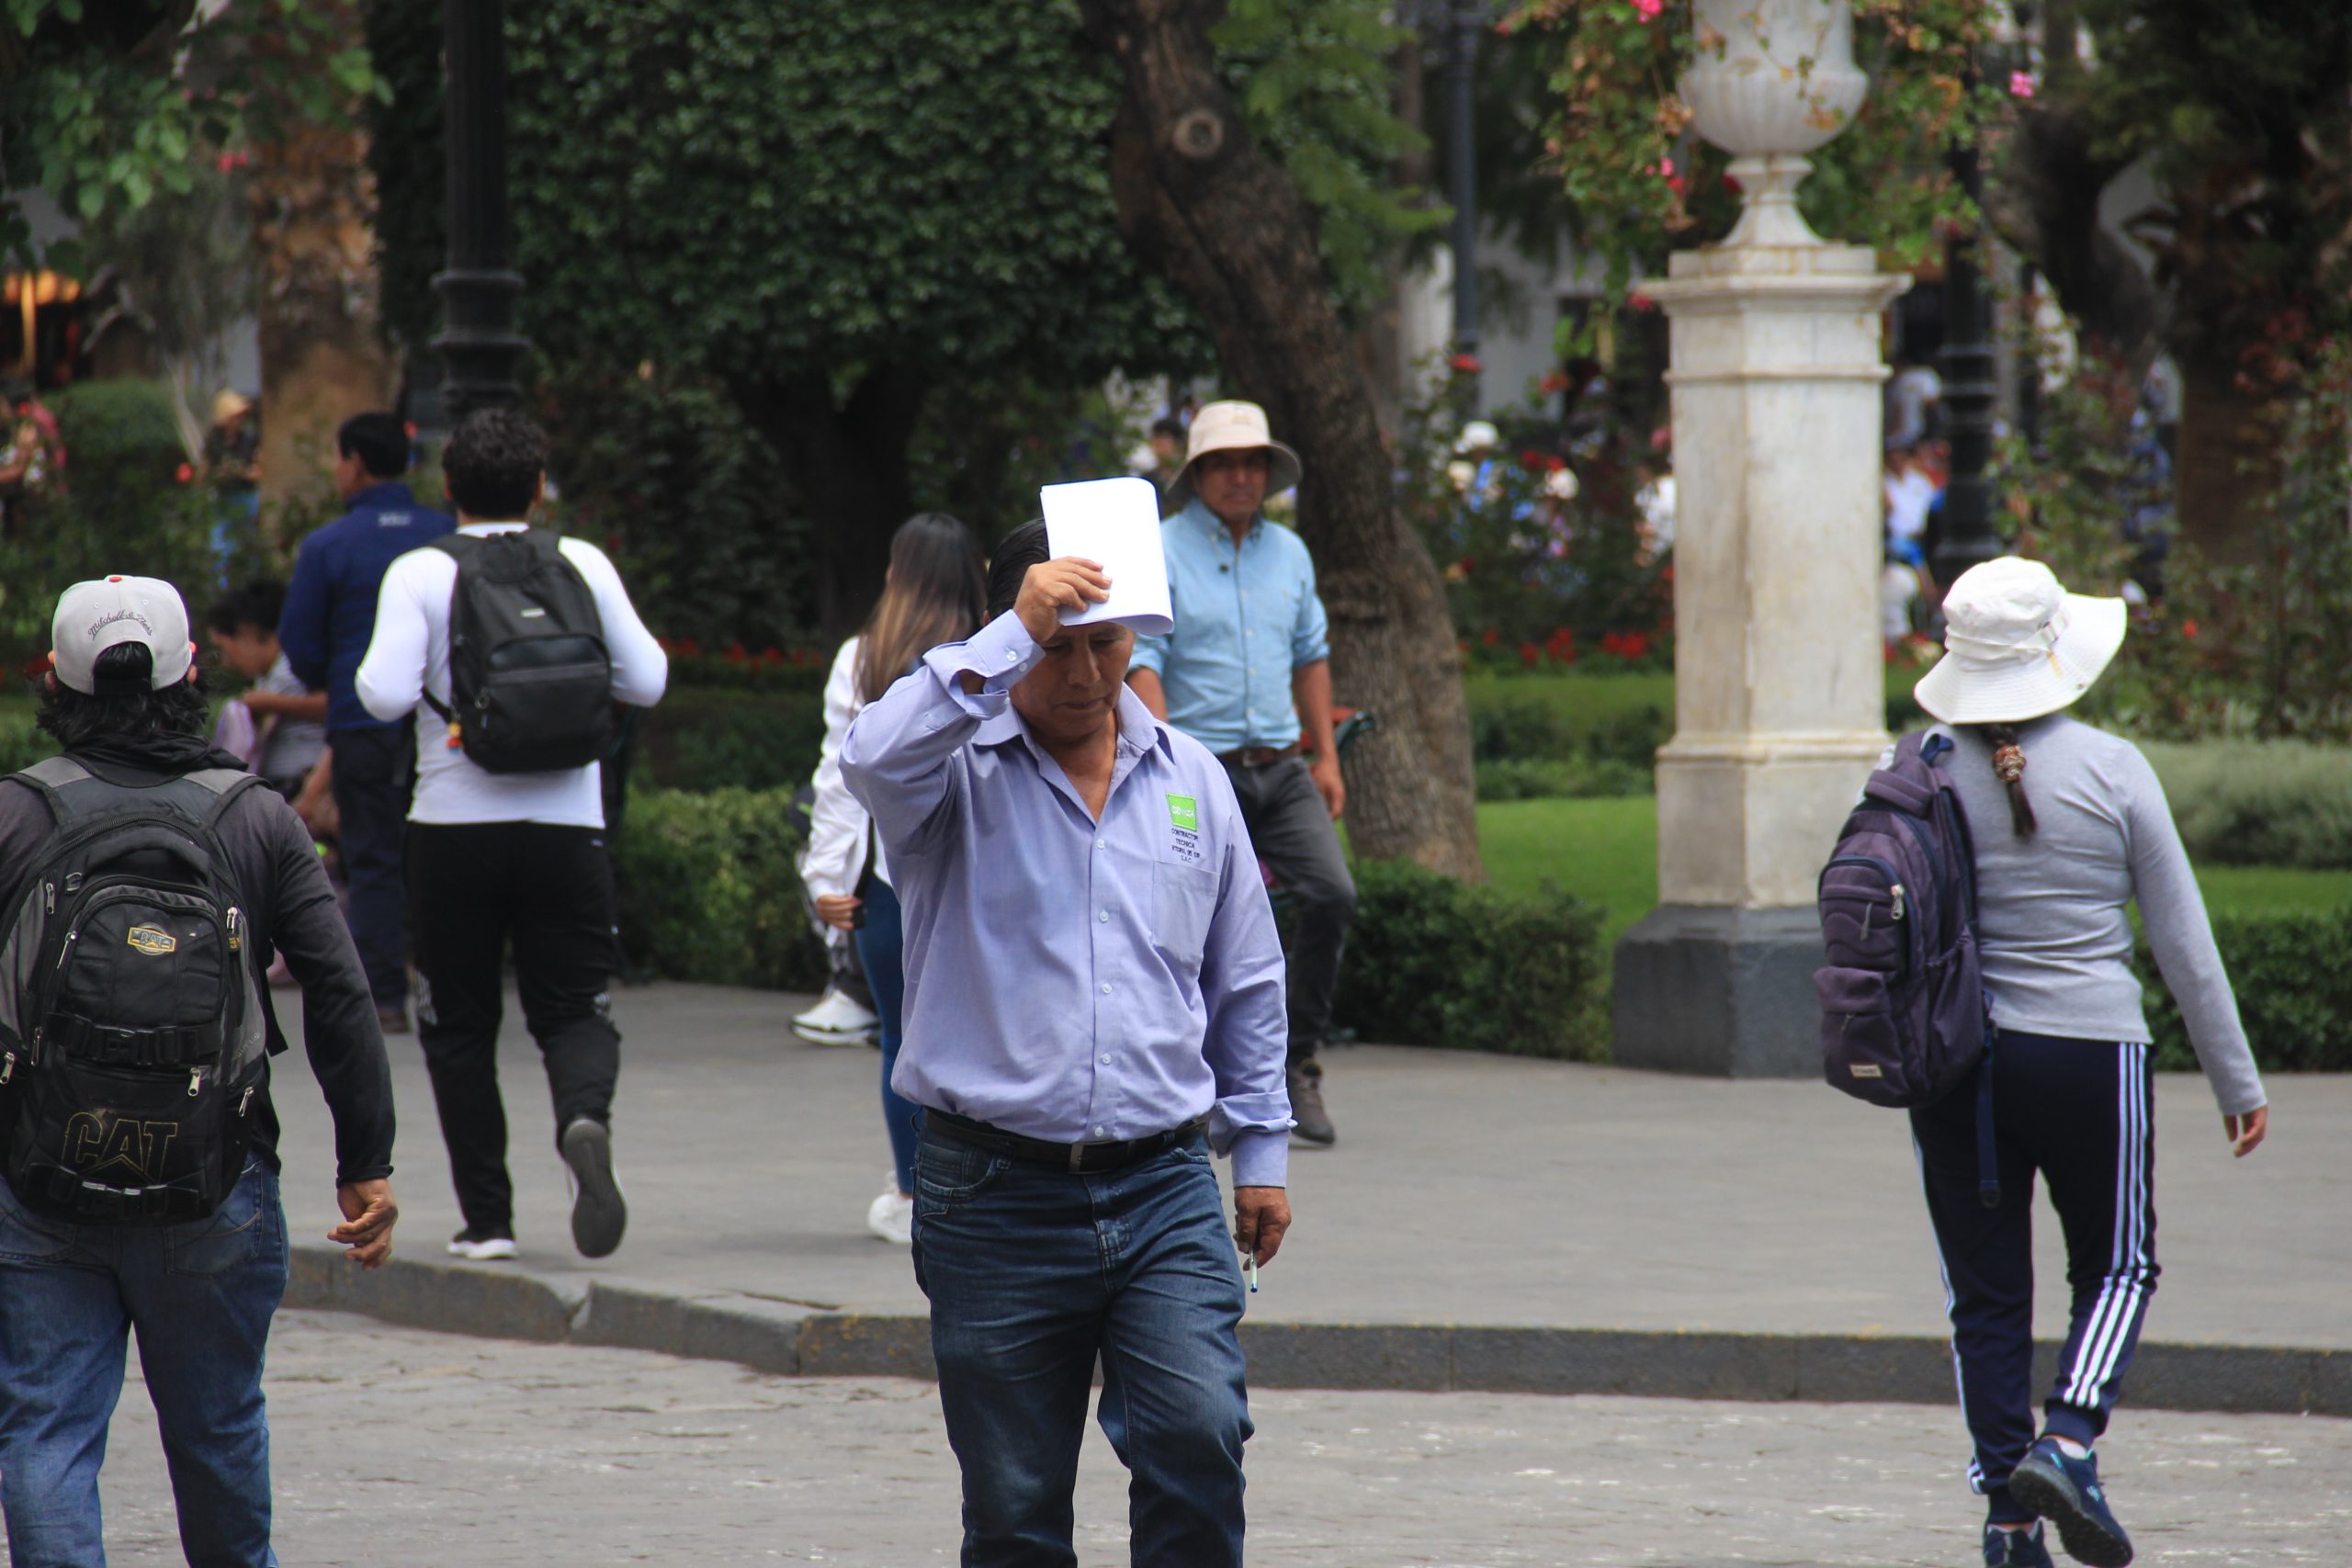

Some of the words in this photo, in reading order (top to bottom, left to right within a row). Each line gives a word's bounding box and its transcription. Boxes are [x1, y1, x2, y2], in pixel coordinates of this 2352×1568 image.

[88, 609, 126, 641] Mitchell
[141, 931, 165, 947] CAT
[62, 1111, 178, 1183] CAT
